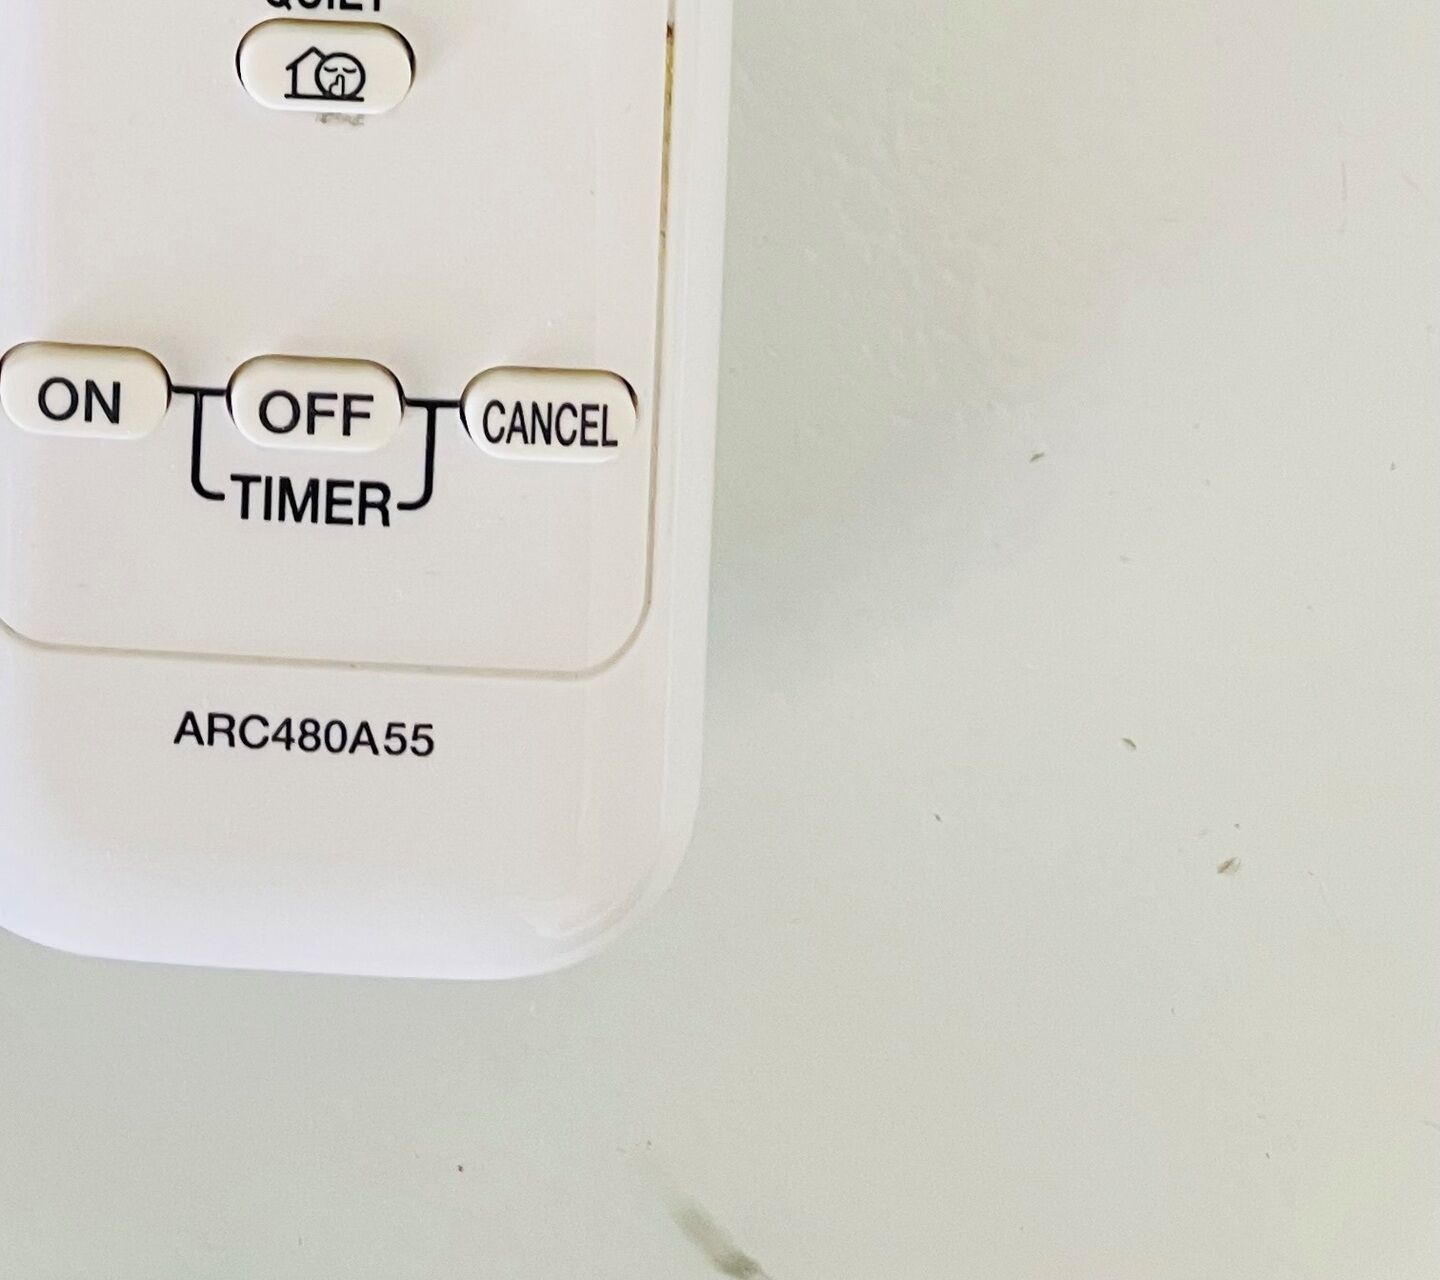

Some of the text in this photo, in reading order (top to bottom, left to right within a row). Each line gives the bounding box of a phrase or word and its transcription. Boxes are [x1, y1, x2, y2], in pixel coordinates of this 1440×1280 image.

[38, 377, 120, 424] ON
[259, 390, 373, 436] OFF
[483, 400, 618, 446] CANCEL
[231, 474, 390, 527] TIMER
[174, 711, 433, 756] ARC480A55
